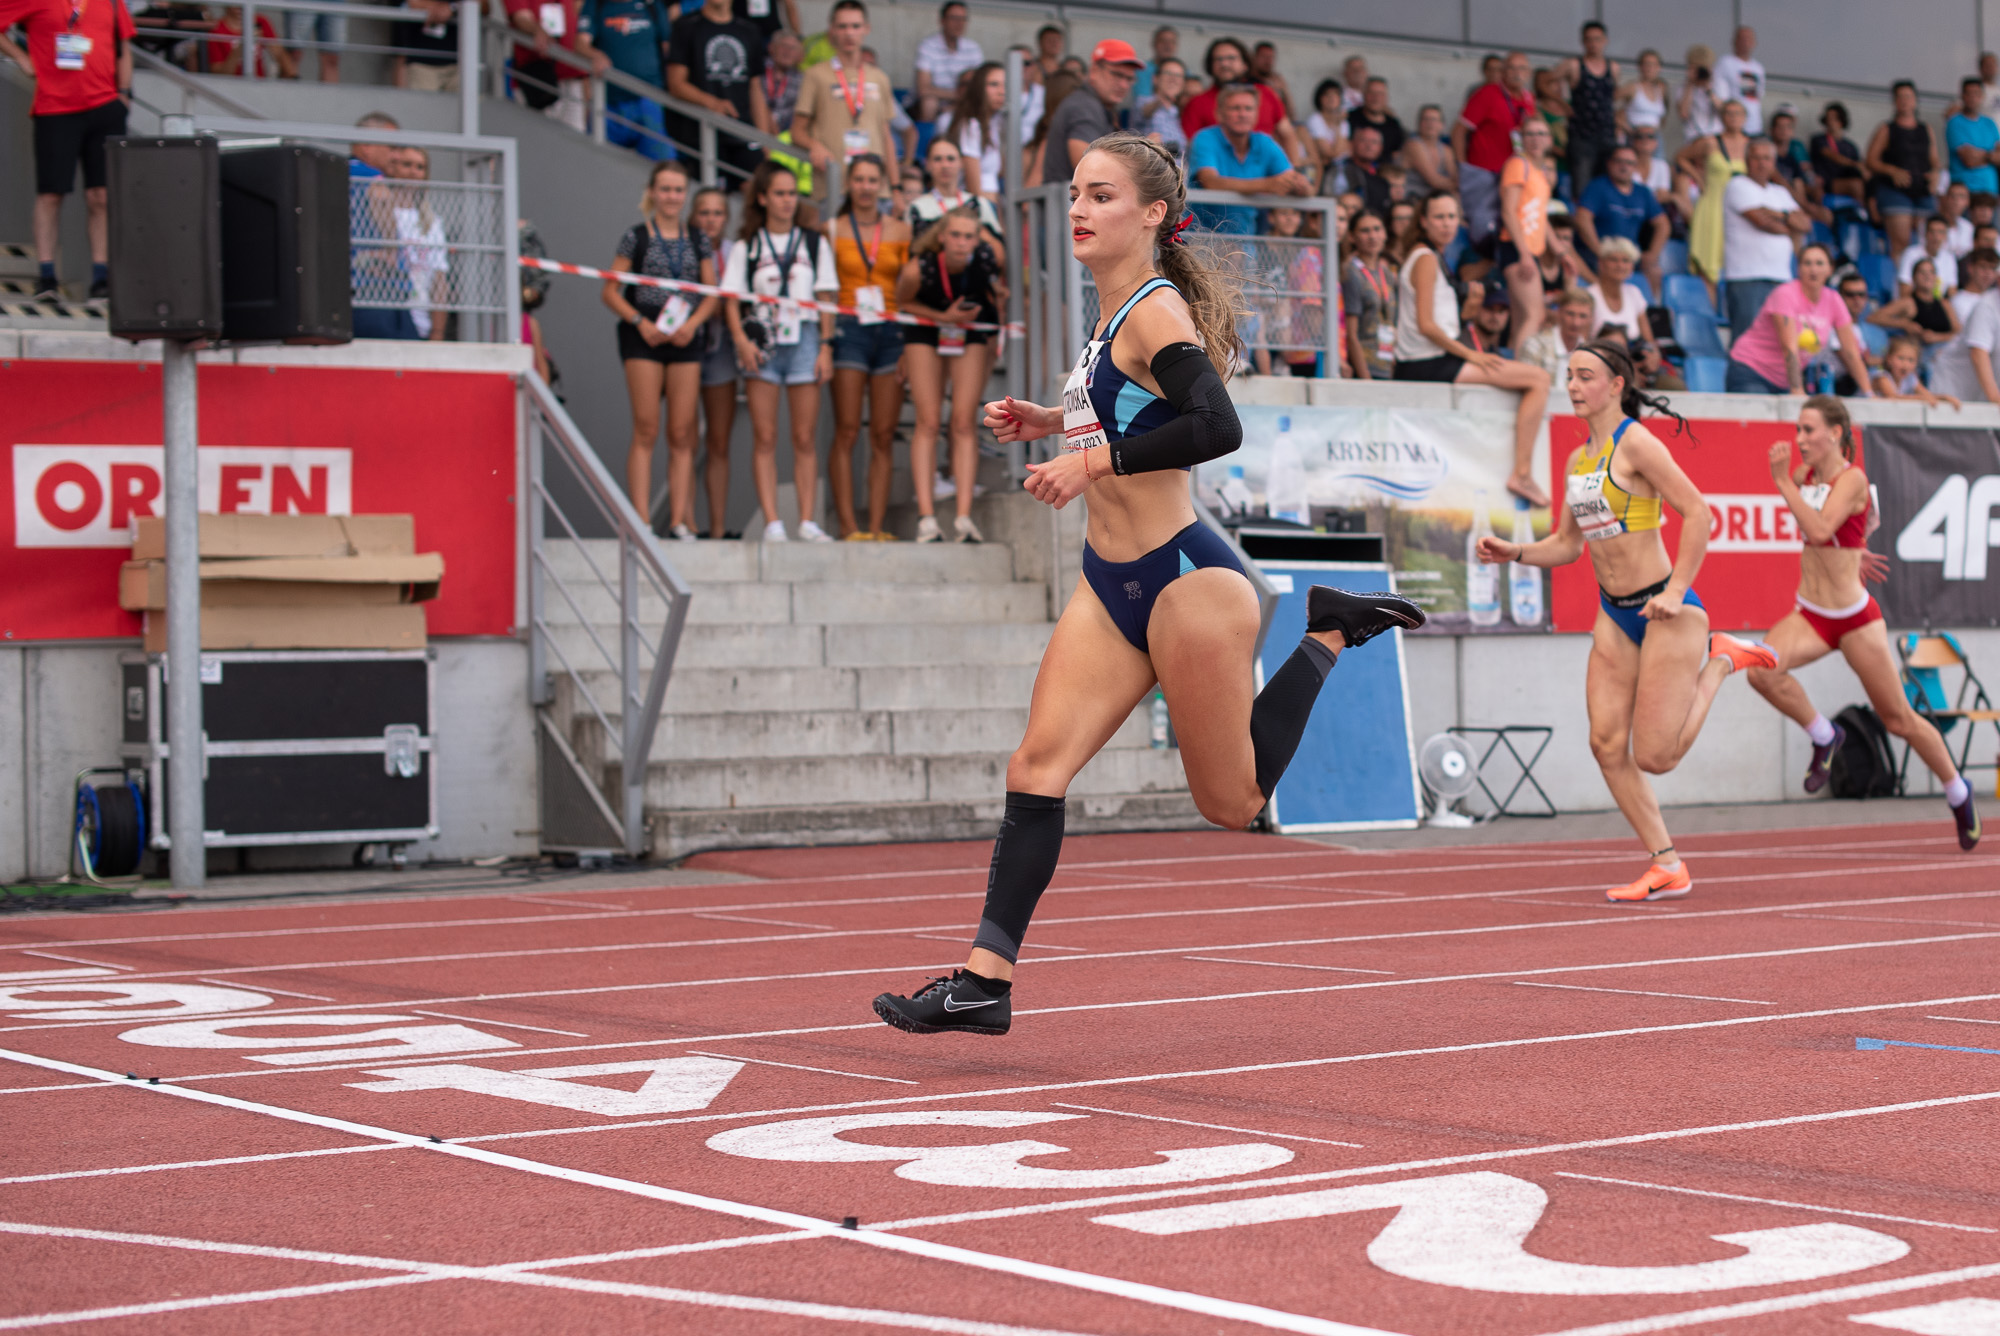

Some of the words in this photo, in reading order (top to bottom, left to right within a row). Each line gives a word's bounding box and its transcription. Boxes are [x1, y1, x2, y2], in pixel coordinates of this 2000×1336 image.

[1083, 435, 1102, 449] 2021
[35, 461, 329, 531] OREN
[1709, 504, 1802, 541] RLE
[1896, 473, 2000, 580] 4F
[117, 1015, 523, 1066] 5
[342, 1056, 746, 1117] 4
[705, 1109, 1295, 1189] 3
[1091, 1171, 1911, 1295] 2
